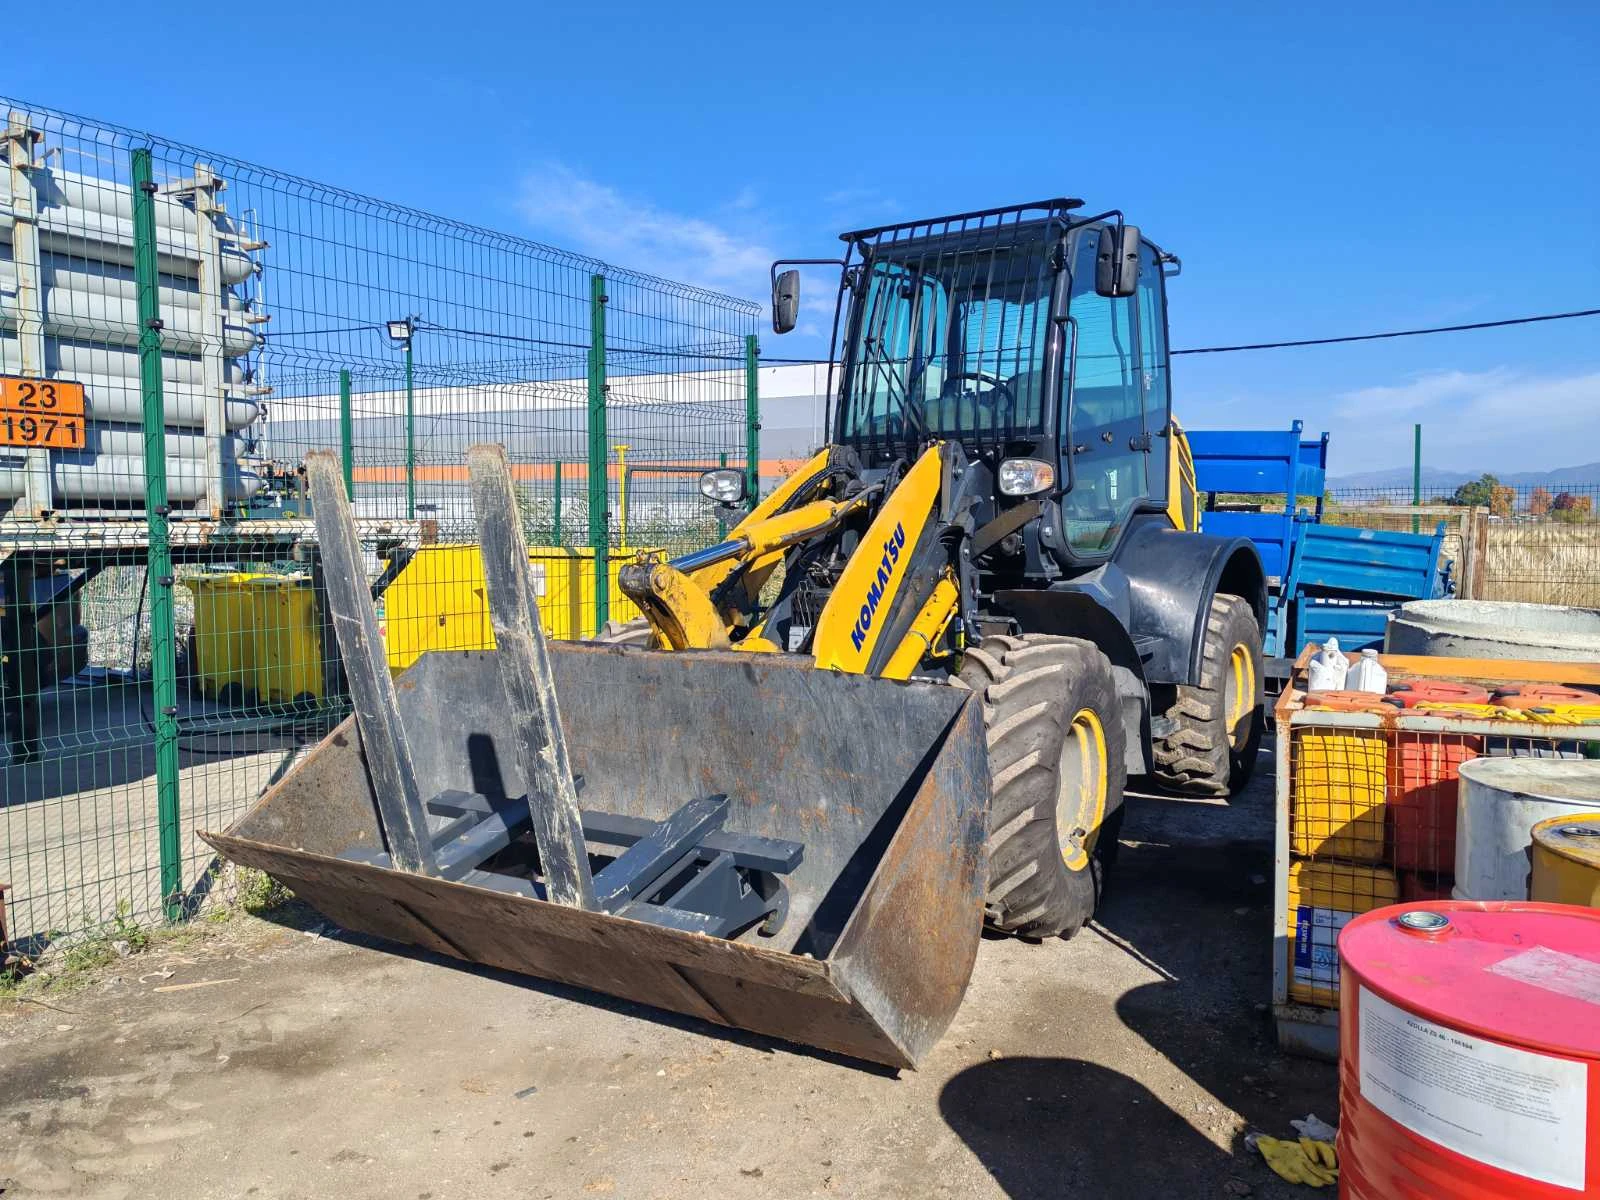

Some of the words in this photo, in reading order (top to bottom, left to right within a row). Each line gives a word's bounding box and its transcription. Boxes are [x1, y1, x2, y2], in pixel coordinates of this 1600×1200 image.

[18, 382, 57, 408] 23
[2, 416, 77, 444] 1971
[851, 521, 905, 653] KOMATSU
